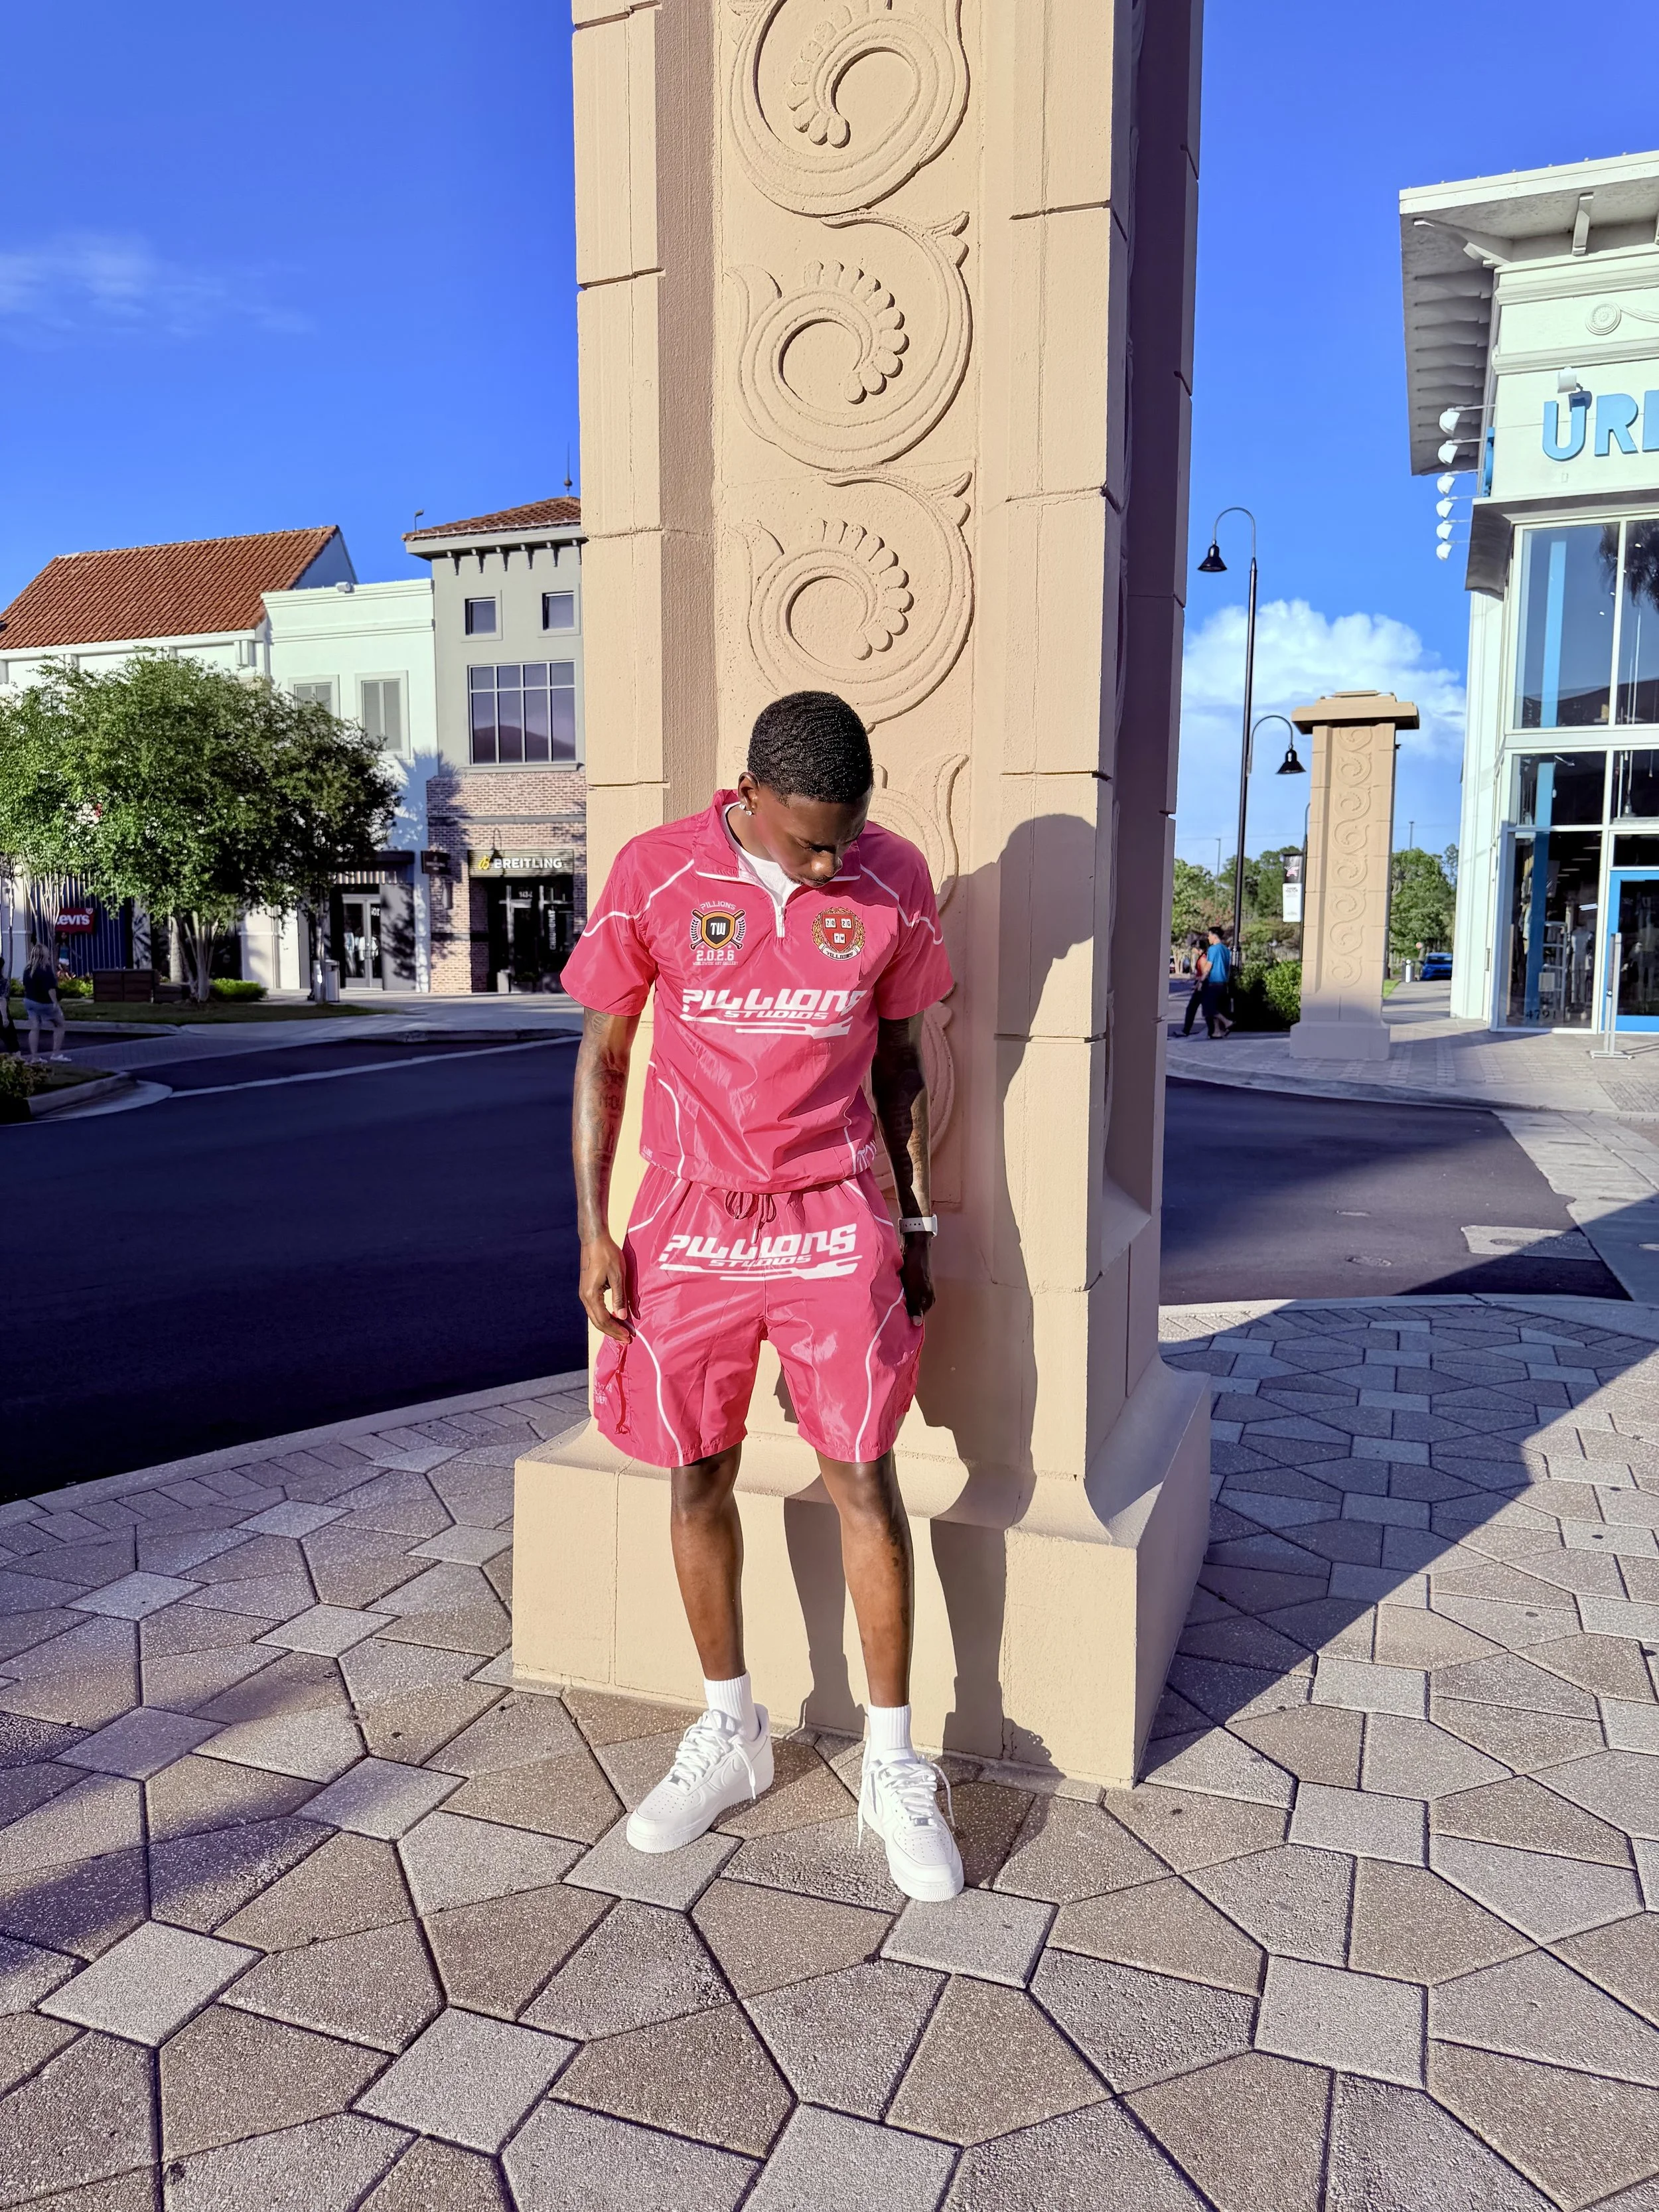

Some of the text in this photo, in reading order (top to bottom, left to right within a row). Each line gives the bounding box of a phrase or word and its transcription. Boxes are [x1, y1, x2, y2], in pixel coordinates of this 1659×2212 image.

[493, 857, 562, 869] BREITLING
[700, 901, 736, 910] PILLIONS
[57, 914, 90, 925] evi's
[710, 922, 726, 935] TW
[696, 950, 735, 961] 2.0.2.6
